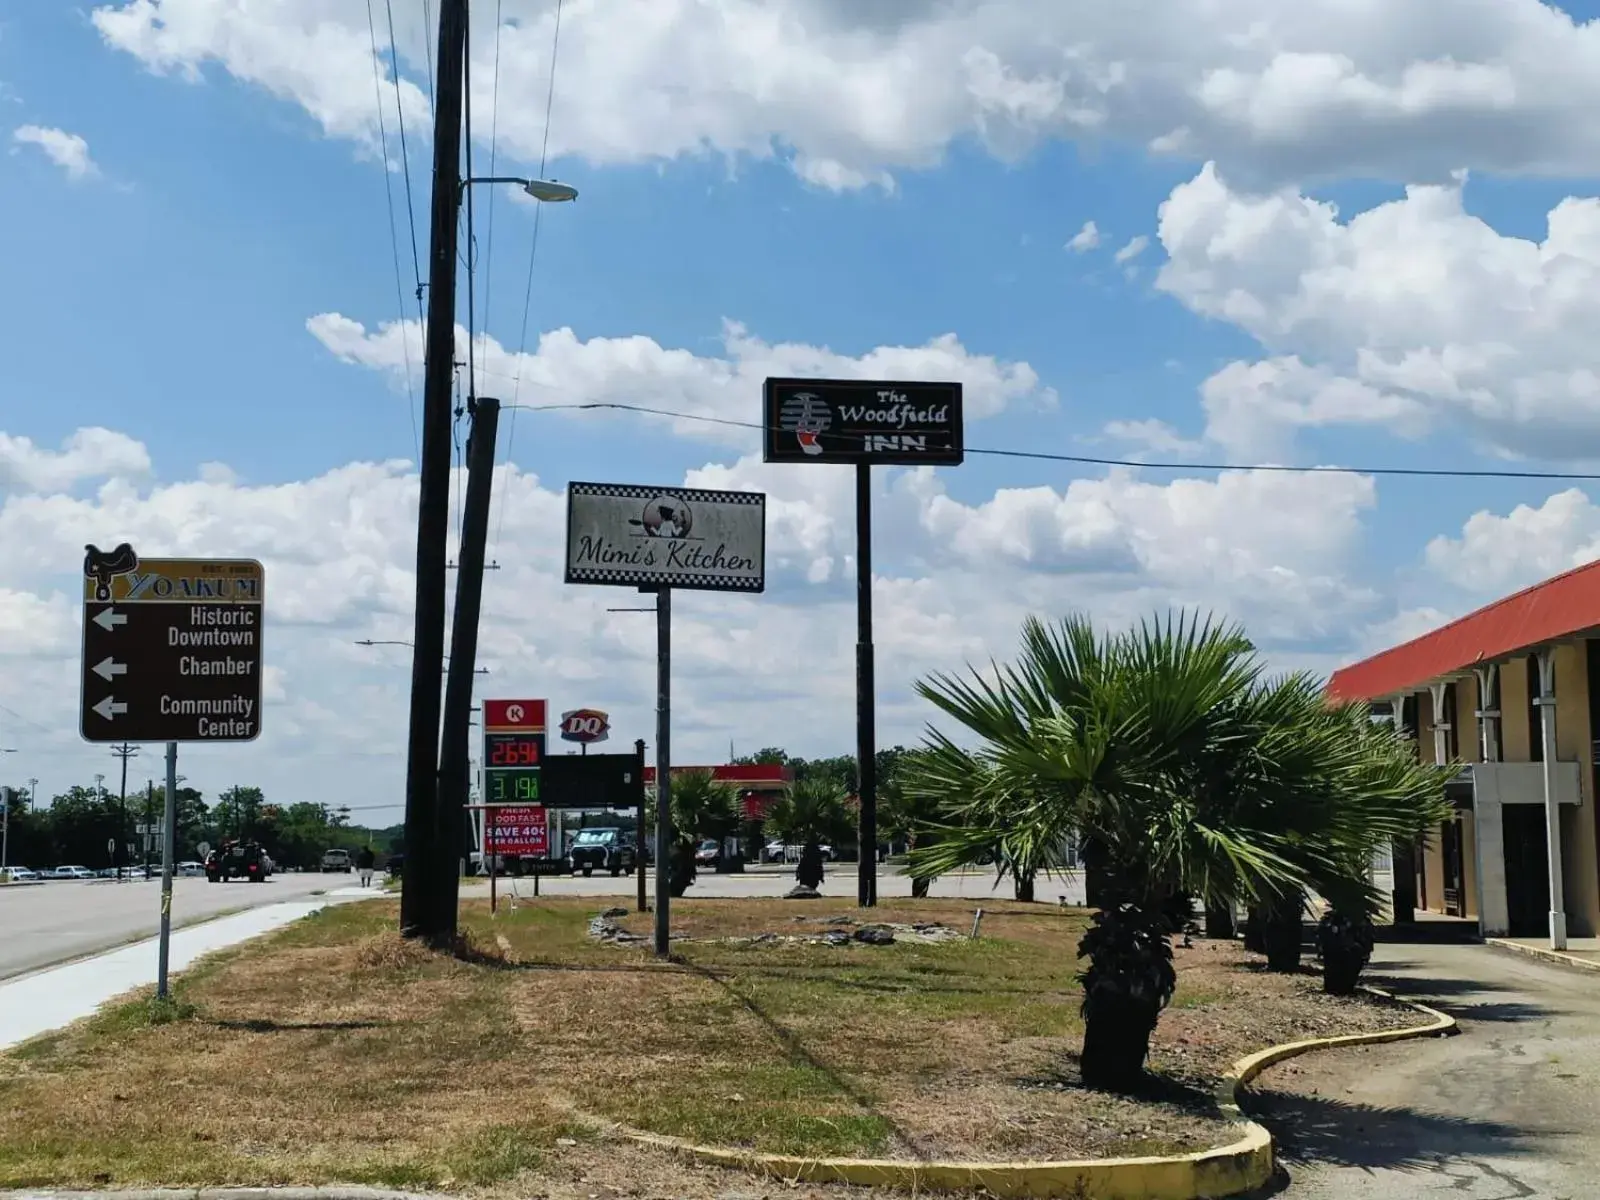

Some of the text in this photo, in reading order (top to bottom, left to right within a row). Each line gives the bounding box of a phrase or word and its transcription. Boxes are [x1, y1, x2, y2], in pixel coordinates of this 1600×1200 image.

[877, 390, 908, 403] The
[838, 404, 949, 429] Woodfield
[576, 535, 756, 571] Mimi's Kitchen
[125, 573, 259, 600] YOAKUM
[191, 606, 254, 625] Historic
[168, 627, 254, 646] Downtown
[179, 656, 254, 675] Chamber
[160, 694, 254, 718] Community
[198, 718, 254, 737] Center
[568, 716, 603, 736] DQ
[486, 826, 519, 837] SAVE
